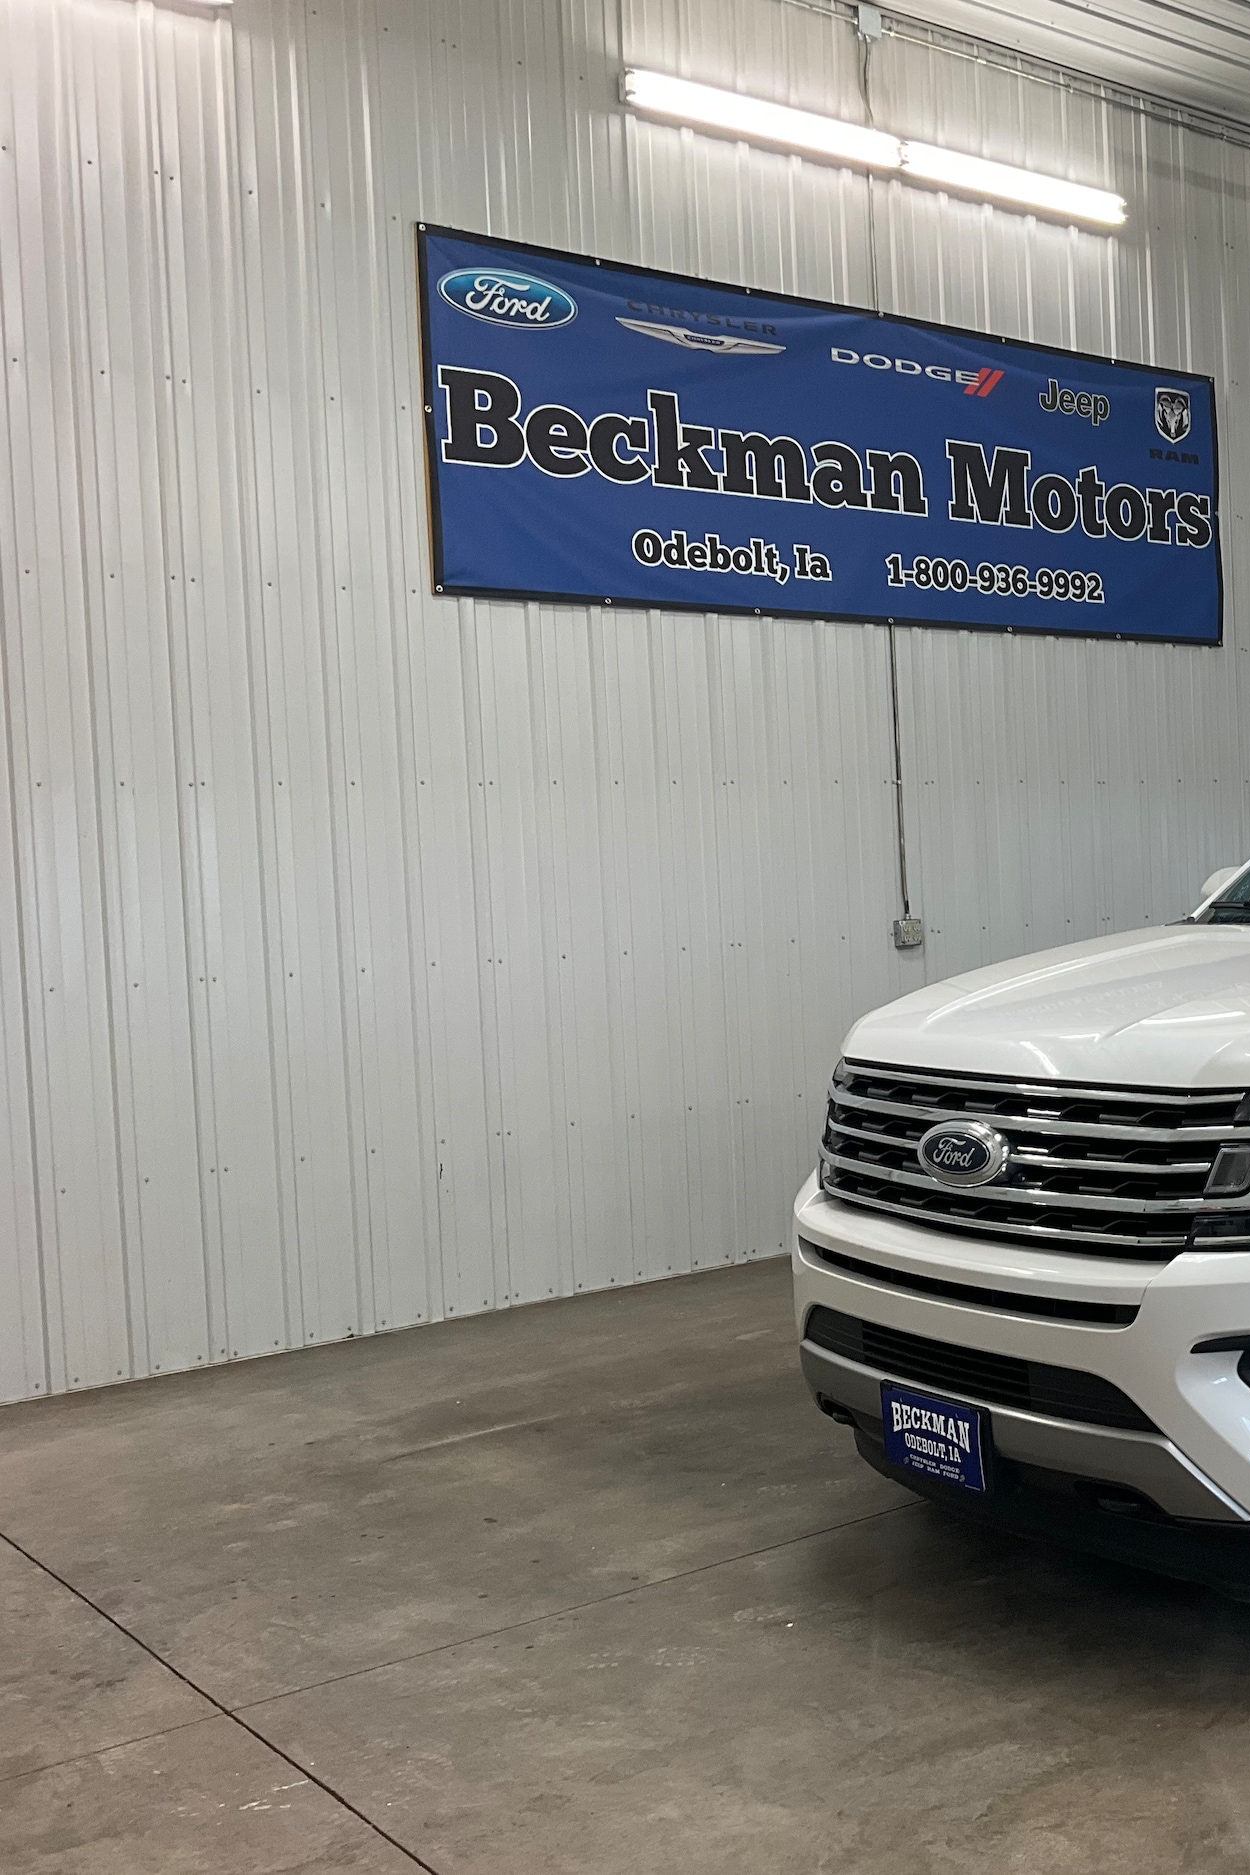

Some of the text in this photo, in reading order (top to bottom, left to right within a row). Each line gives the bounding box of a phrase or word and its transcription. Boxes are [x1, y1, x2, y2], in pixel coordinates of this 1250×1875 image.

[465, 275, 552, 323] Ford
[626, 300, 778, 336] CHRYSLER
[830, 347, 981, 386] DODGE
[1039, 379, 1111, 426] Jeep
[437, 364, 1213, 549] Beckman Motors
[1149, 447, 1200, 466] RAM
[632, 529, 832, 586] Odebolt, Ia
[885, 553, 1105, 604] 1-800-936-9992
[932, 1136, 976, 1168] Ford
[891, 1401, 971, 1454] BECKMAN
[904, 1432, 961, 1463] ODEBOLT, IA
[939, 1463, 960, 1474] DODGE
